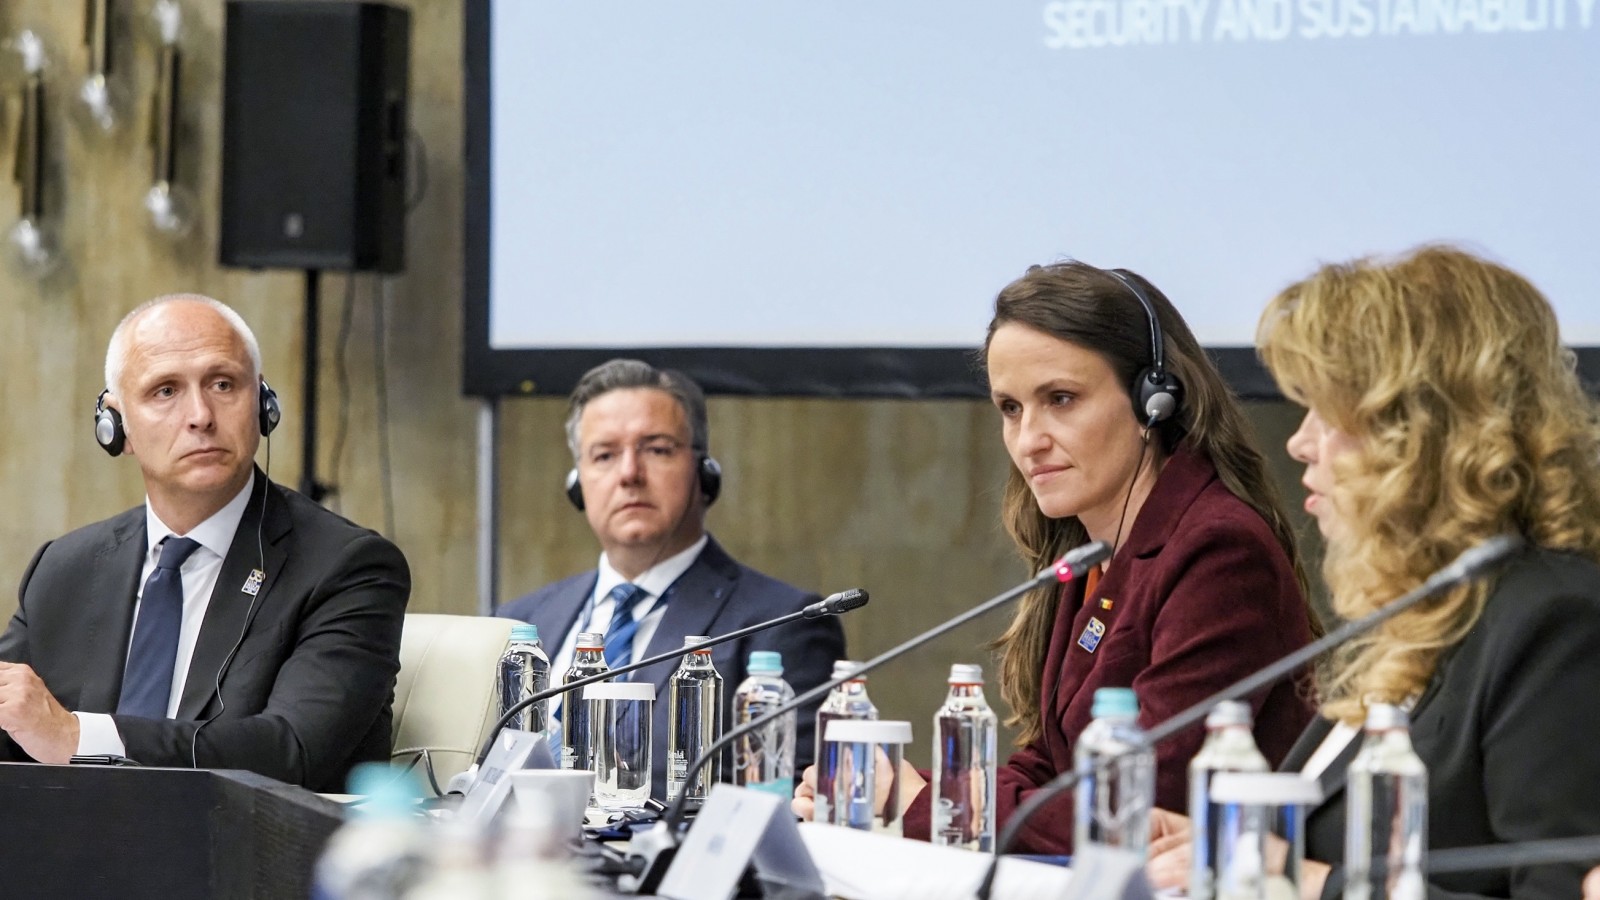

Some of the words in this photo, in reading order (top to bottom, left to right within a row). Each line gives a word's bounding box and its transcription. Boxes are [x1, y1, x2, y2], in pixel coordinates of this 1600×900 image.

[1043, 0, 1208, 48] SECURITY
[1213, 0, 1290, 41] AND
[1299, 0, 1597, 38] SUSTAINABILITY
